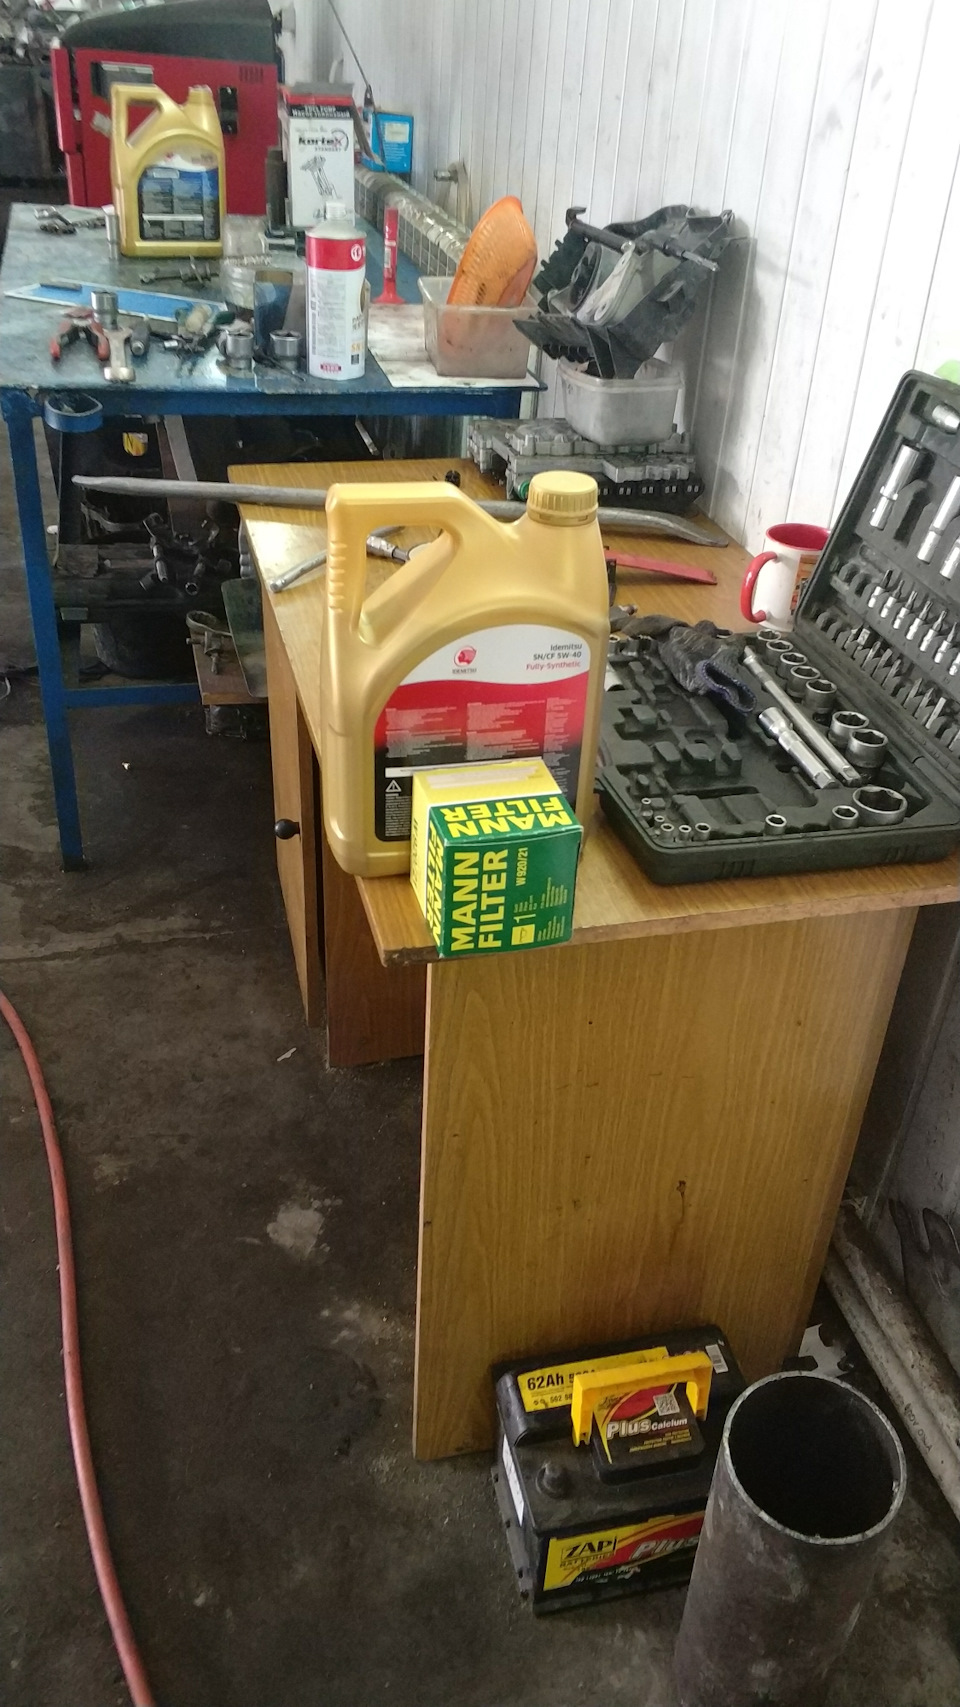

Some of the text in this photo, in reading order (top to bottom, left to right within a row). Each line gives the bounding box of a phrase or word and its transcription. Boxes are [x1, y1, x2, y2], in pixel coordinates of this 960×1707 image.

[533, 651, 582, 661] SN/CF 5W-40
[550, 643, 583, 651] Idemitsu
[526, 661, 581, 671] Fully-Synthetic
[440, 796, 564, 822] FILTER
[447, 811, 573, 838] MANN
[426, 820, 437, 929] FILTER
[432, 835, 444, 947] MANN
[451, 852, 480, 951] MANN
[478, 849, 508, 948] FILTER
[527, 1373, 564, 1391] 62Ah
[606, 1418, 688, 1440] Plus Calcium
[565, 1540, 613, 1558] ZAP
[628, 1536, 700, 1560] Plus
